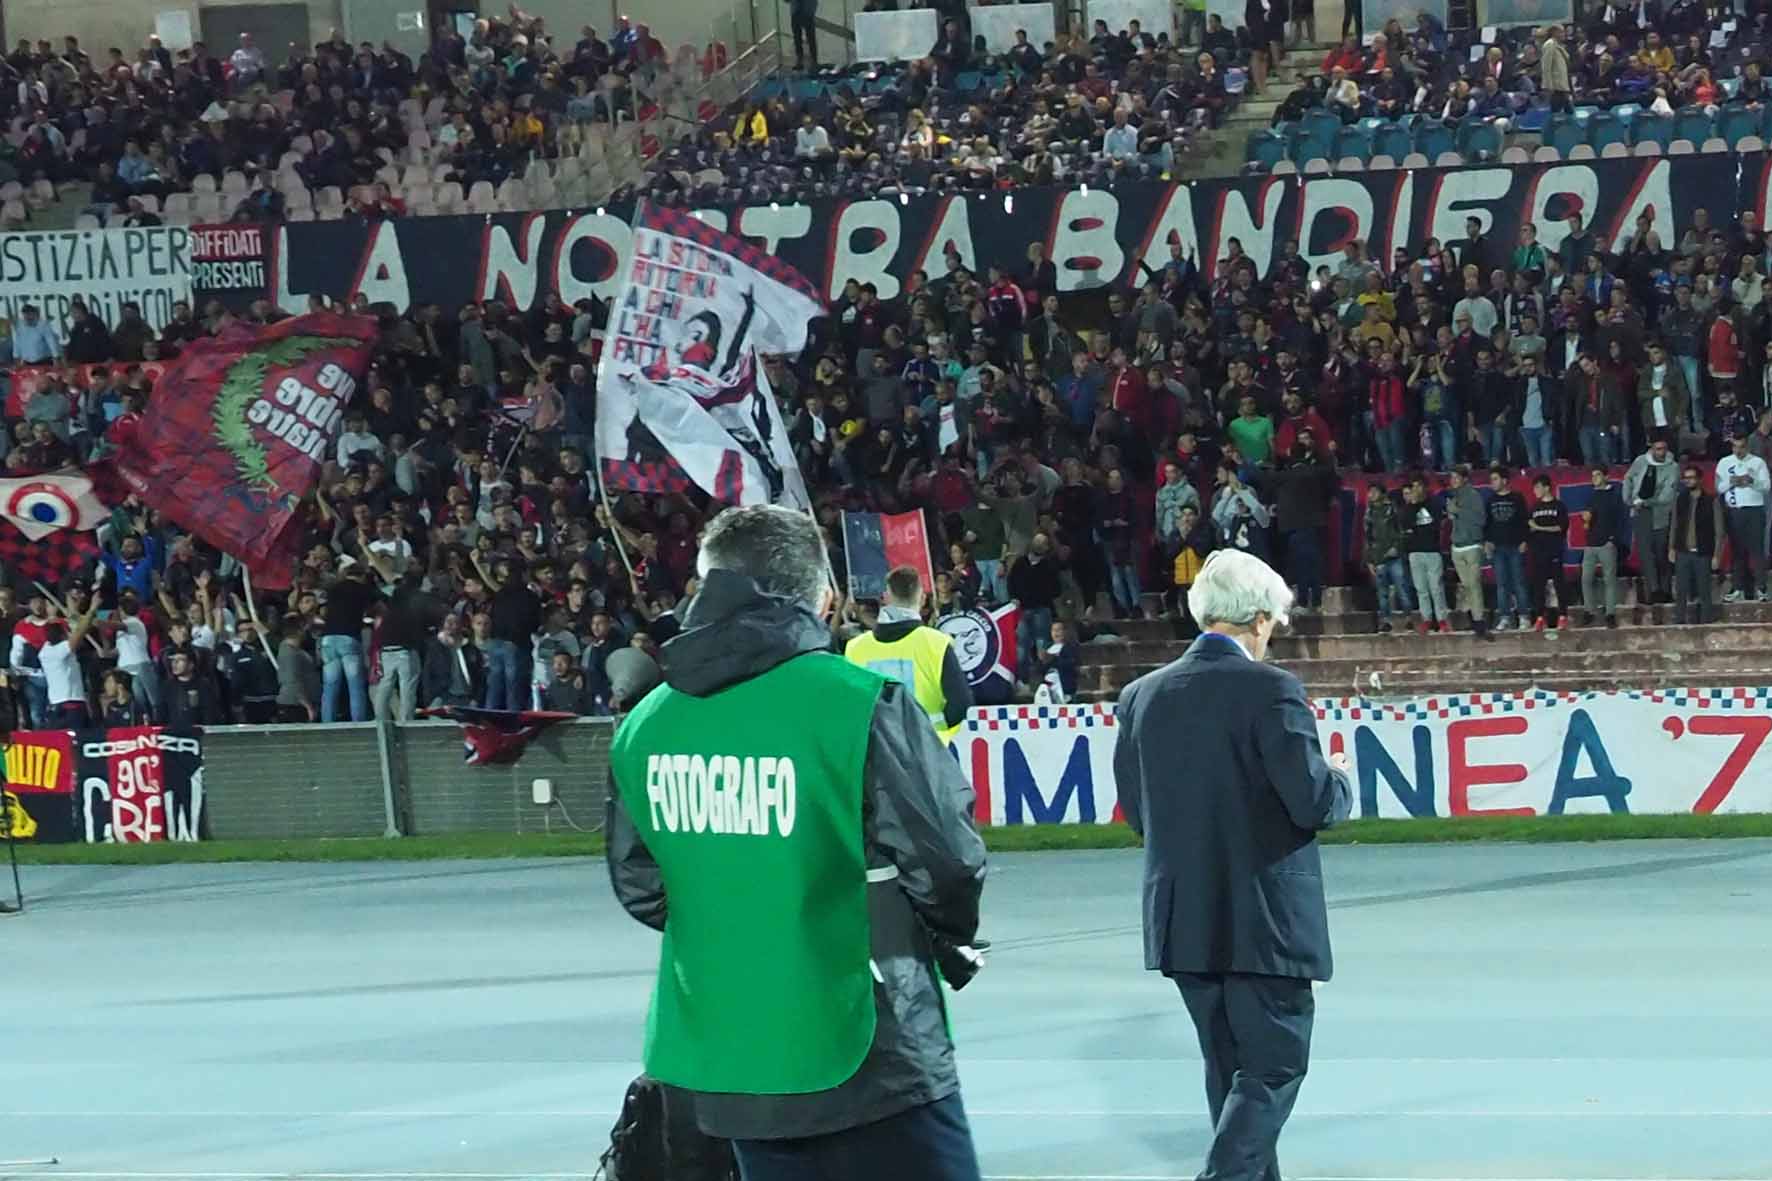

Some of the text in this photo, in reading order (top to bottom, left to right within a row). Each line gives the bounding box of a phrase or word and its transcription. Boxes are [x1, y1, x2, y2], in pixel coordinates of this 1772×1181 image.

[124, 227, 191, 279] PER
[272, 225, 410, 314] LA
[1052, 159, 1676, 293] BANDIERA
[647, 753, 796, 838] FOTOGRAFO
